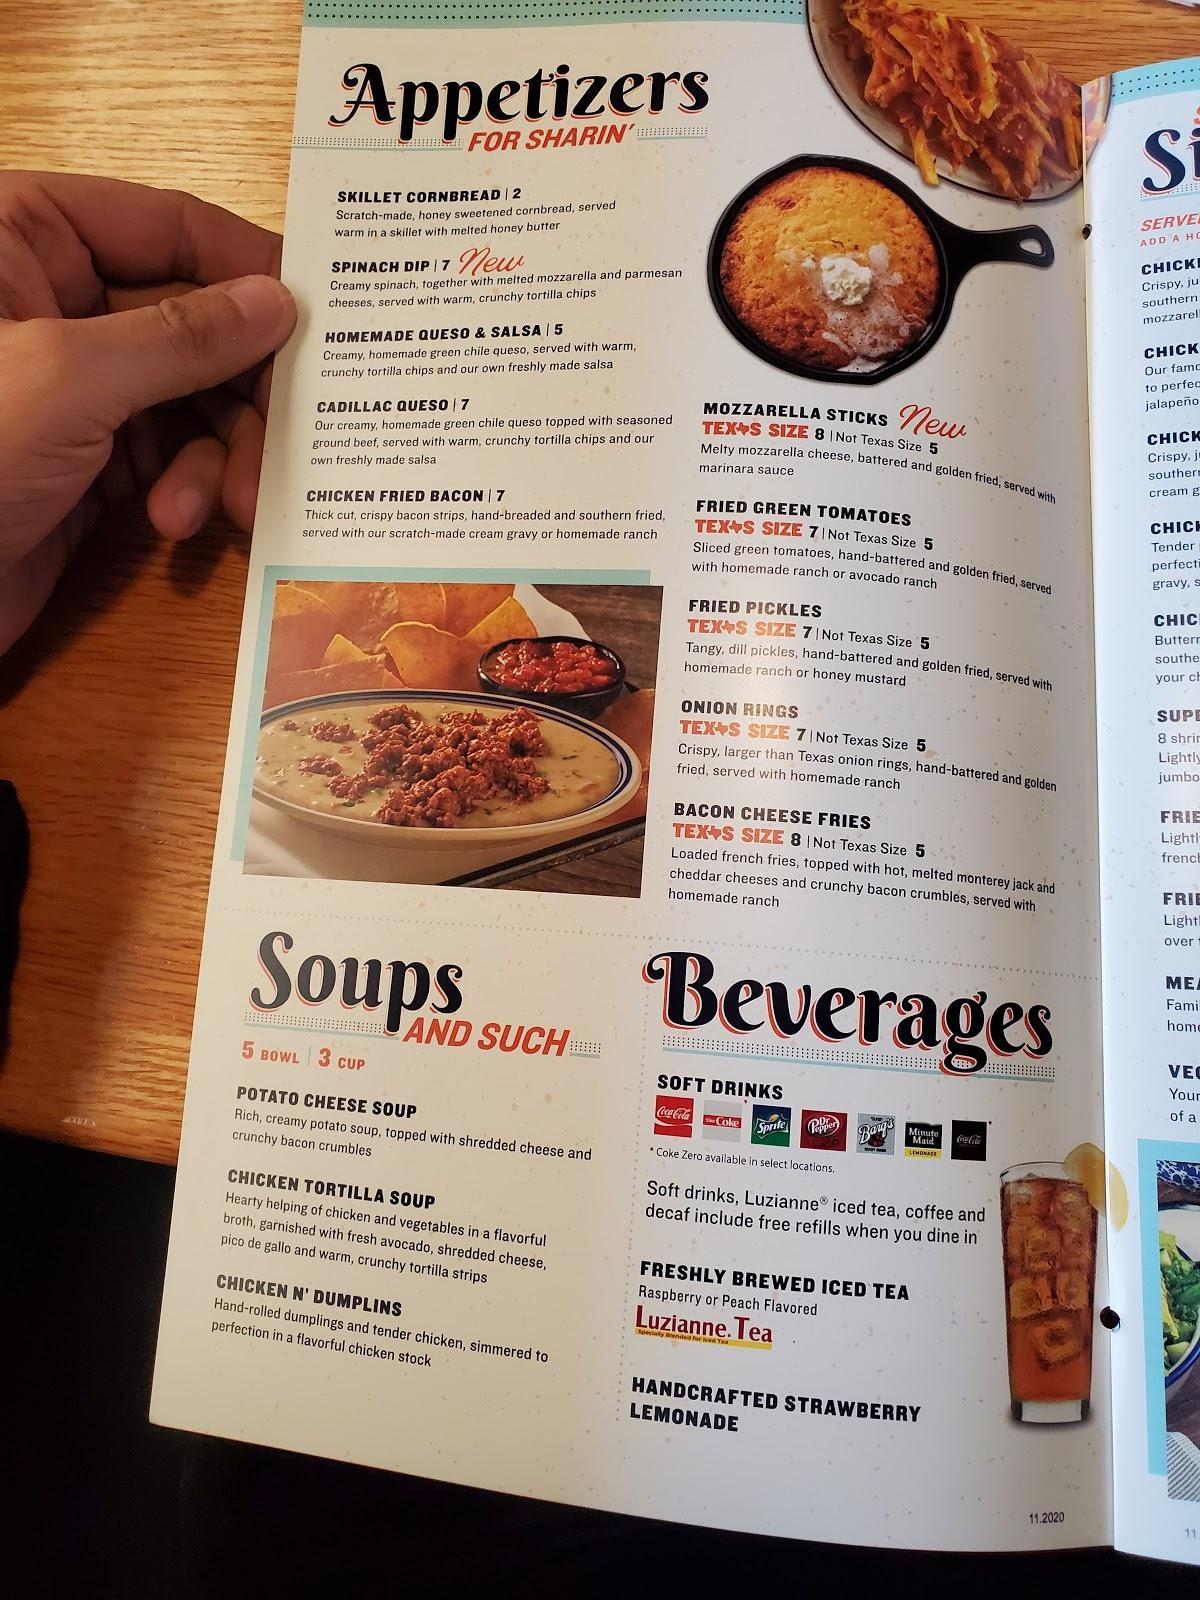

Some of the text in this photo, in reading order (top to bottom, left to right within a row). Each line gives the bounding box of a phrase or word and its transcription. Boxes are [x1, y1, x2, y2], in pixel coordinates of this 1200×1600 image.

[328, 63, 709, 144] Appetizers
[468, 123, 636, 152] FOR SHARIN'
[337, 187, 521, 203] SKILLET CORNBREAD 2
[335, 200, 616, 221] Scratch-made, honey sweetened cornbread, served
[1140, 234, 1180, 247] ADD A
[331, 247, 525, 278] SPINACH DIP 7 New
[1142, 278, 1184, 292] Crispy,
[1142, 294, 1198, 309] southern
[325, 323, 563, 343] HOMEMADE QUESO & SALSA 5
[1144, 365, 1167, 376] Our
[1145, 384, 1158, 393] to
[316, 398, 470, 413] CADILLAC QUESO 7
[703, 402, 967, 439] MOZZARELLA STICKS New
[768, 423, 938, 455] SIZE 8 Not Texas Size 5
[310, 454, 436, 467] own freshly made salsa
[1148, 450, 1191, 463] Crispy,
[700, 443, 1056, 504] Melty mozzarella cheese, battered and golden fried, served with
[306, 489, 505, 502] CHICKEN FRIED BACON 7
[1149, 486, 1188, 498] cream
[696, 499, 911, 526] FRIED GREEN TOMATOES
[1151, 541, 1195, 553] Tender
[1152, 578, 1190, 591] gravy,
[688, 599, 822, 618] FRIED PICKLES
[1155, 673, 1185, 685] your
[681, 699, 798, 719] ONION RINGS
[1157, 732, 1167, 744] 8
[674, 802, 870, 830] BACON CHEESE FRIES
[1164, 936, 1195, 947] over
[249, 931, 464, 1036] Soups
[641, 952, 1054, 1076] Beverages
[403, 1016, 570, 1057] AND SUCH
[242, 1041, 300, 1065] 5 BOWL
[318, 1047, 365, 1071] 3 CUP
[657, 1074, 783, 1100] SOFT DRINKS
[236, 1086, 417, 1119] POTATO CHEESE SOUP
[716, 1116, 741, 1128] Coke
[757, 1120, 787, 1135] Sprite
[811, 1119, 839, 1135] Pepper
[908, 1127, 940, 1138] Minute
[232, 1131, 372, 1157] crunchy bacon crumbles
[912, 1135, 936, 1146] Maid
[656, 1147, 834, 1173] Coke Zero available in select locations.
[227, 1169, 435, 1209] CHICKEN TORTILLA SOUP
[646, 1179, 680, 1198] Soft
[684, 1184, 738, 1206] drinks,
[833, 1198, 866, 1215] iced
[870, 1202, 899, 1219] tea,
[905, 1204, 953, 1221] coffee
[958, 1206, 985, 1222] and
[645, 1202, 977, 1244] decaf include free refills when you dine in
[640, 1260, 909, 1300] FRESHLY BREWED ICED TEA
[216, 1274, 288, 1299] CHICKEN
[313, 1289, 402, 1317] DUMPLINS
[638, 1284, 817, 1316] Raspberry or Peach Flavored
[733, 1316, 773, 1343] Tea
[211, 1321, 431, 1367] perfection in a flavorful chicken stock
[631, 1376, 921, 1422] HANDCRAFTED STRAWBERRY
[629, 1402, 738, 1432] LEMONADE
[1029, 1511, 1065, 1524] 11.2020
